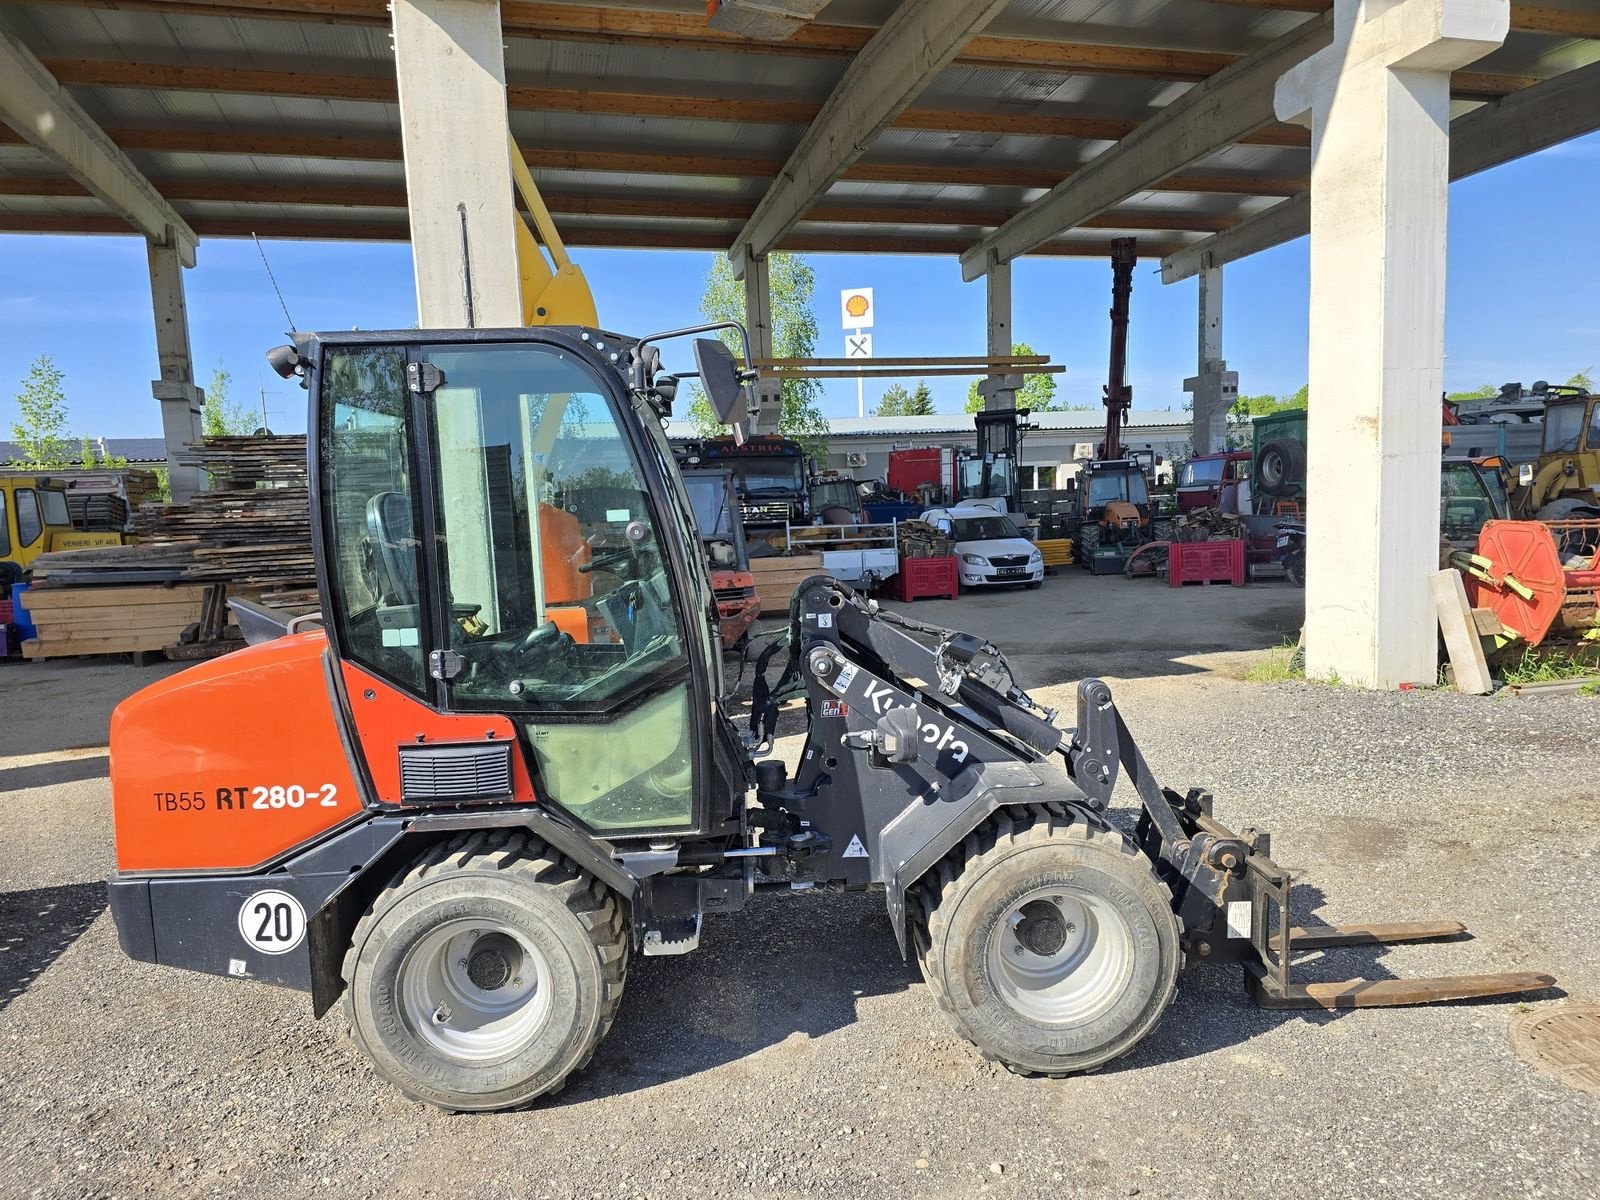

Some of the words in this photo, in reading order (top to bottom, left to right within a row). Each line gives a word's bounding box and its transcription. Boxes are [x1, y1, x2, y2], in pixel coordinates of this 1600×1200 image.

[721, 444, 782, 452] AUSTRIA
[153, 791, 206, 812] TB55
[253, 901, 293, 943] 20
